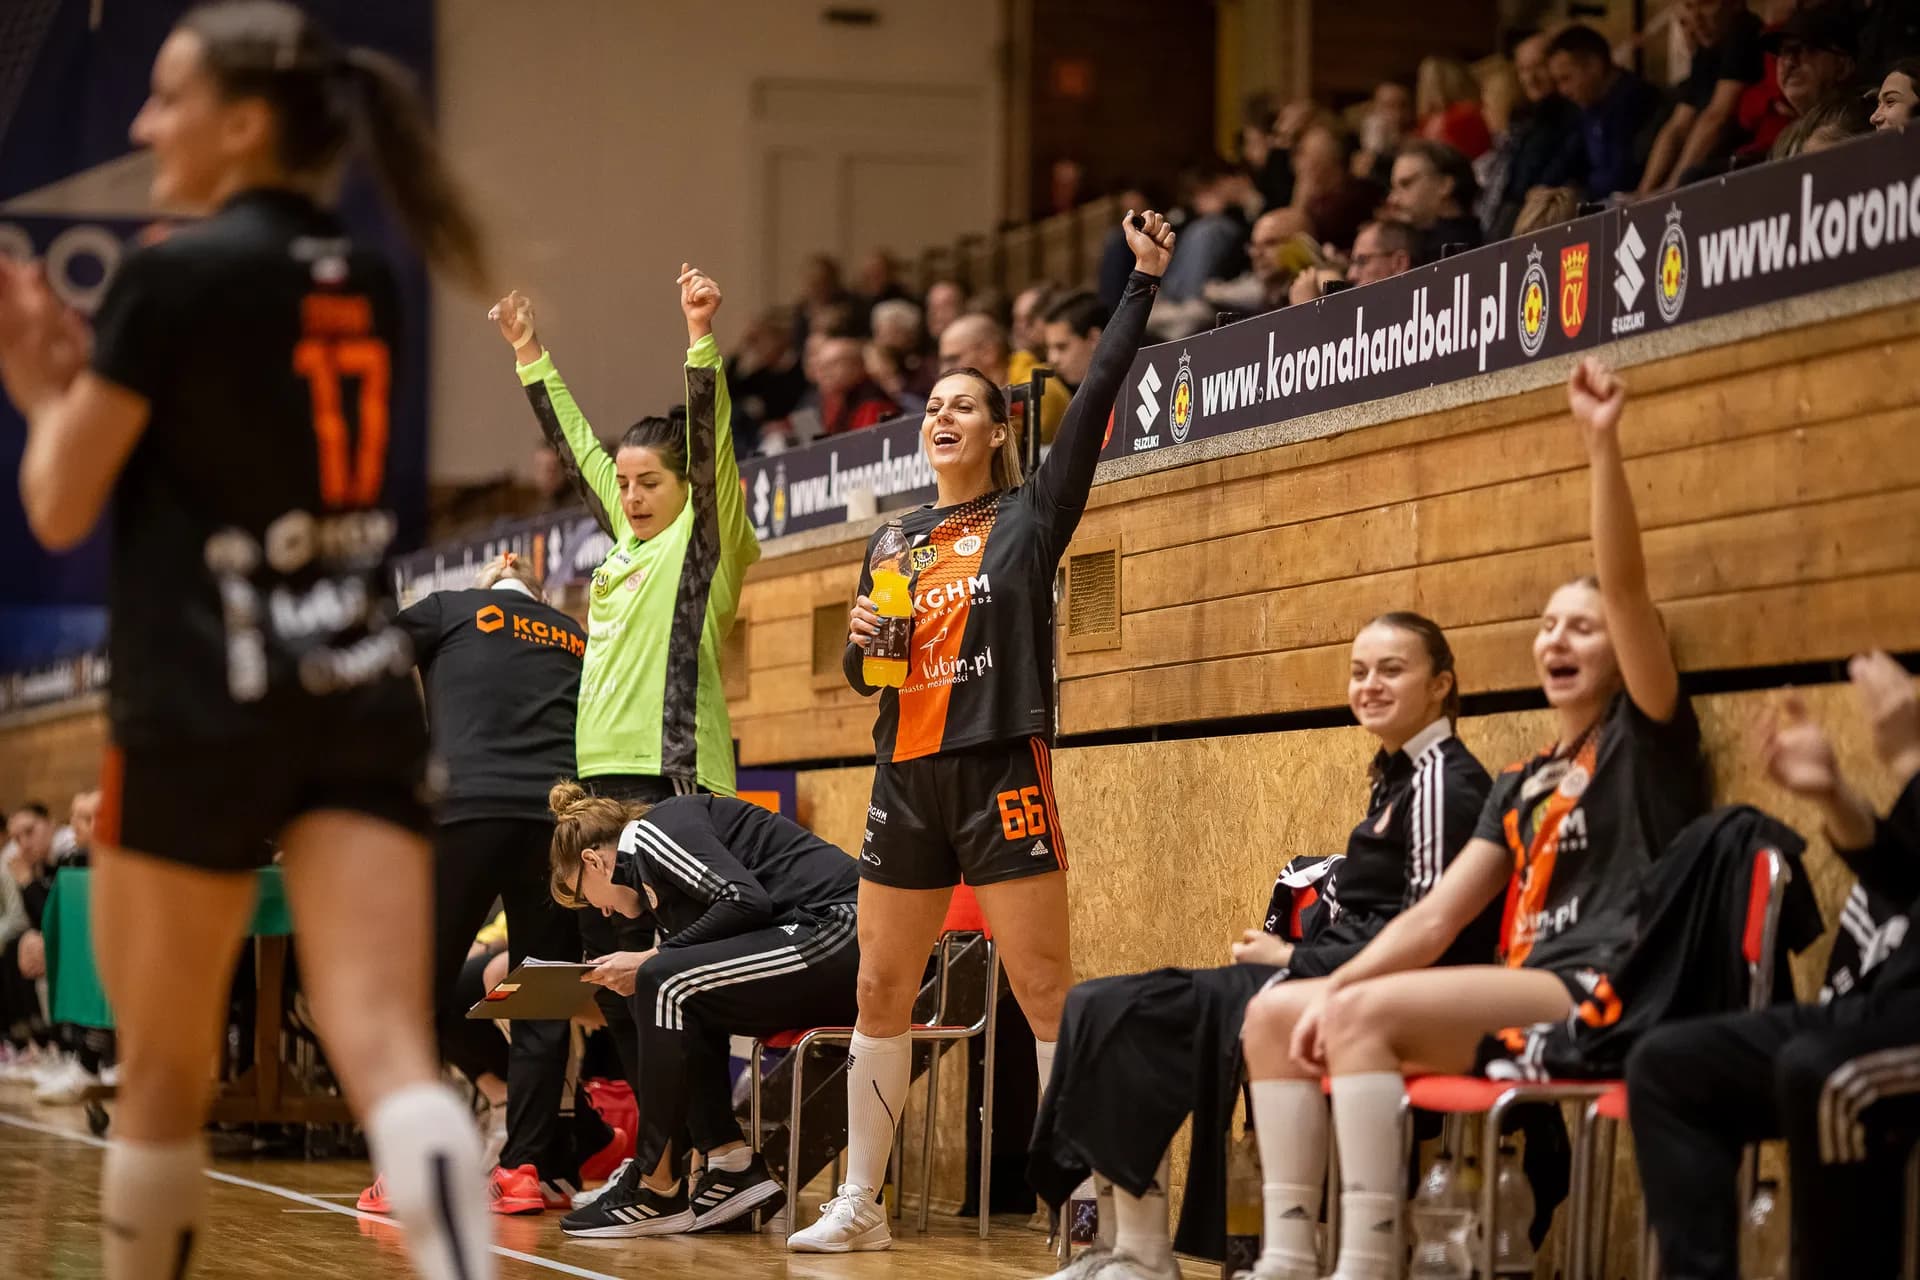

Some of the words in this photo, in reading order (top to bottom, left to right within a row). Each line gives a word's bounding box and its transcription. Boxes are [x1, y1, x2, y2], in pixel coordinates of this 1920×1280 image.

[1562, 281, 1583, 329] CK
[1611, 312, 1645, 334] SUZUKI
[1133, 435, 1160, 451] SUZUKI
[912, 573, 991, 618] KGHM
[513, 614, 585, 657] KGHM
[922, 646, 993, 680] lubin.pl
[996, 785, 1046, 840] 66
